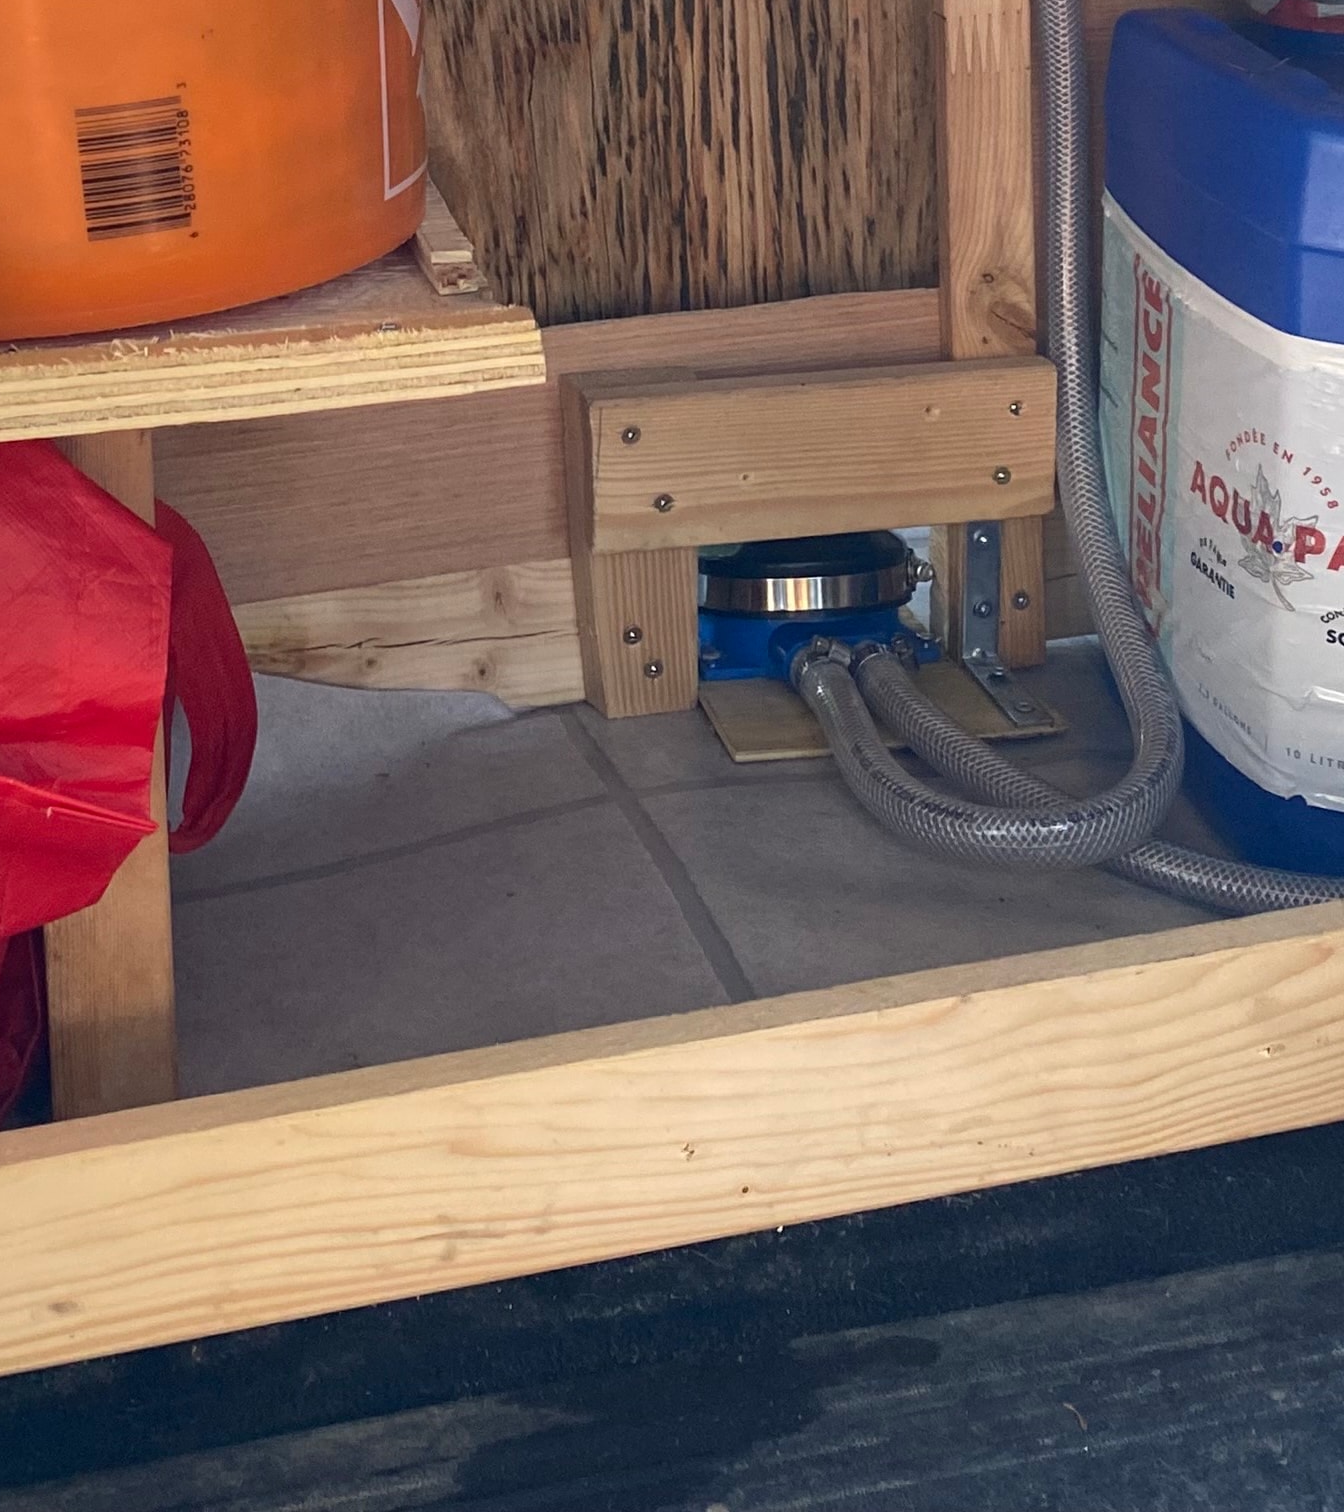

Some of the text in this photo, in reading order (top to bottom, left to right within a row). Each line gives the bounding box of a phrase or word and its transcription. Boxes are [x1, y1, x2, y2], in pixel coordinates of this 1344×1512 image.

[1190, 460, 1274, 554] AQUA
[1273, 442, 1294, 464] EN
[1302, 466, 1340, 510] 1958
[1190, 552, 1235, 600] GARANTIE
